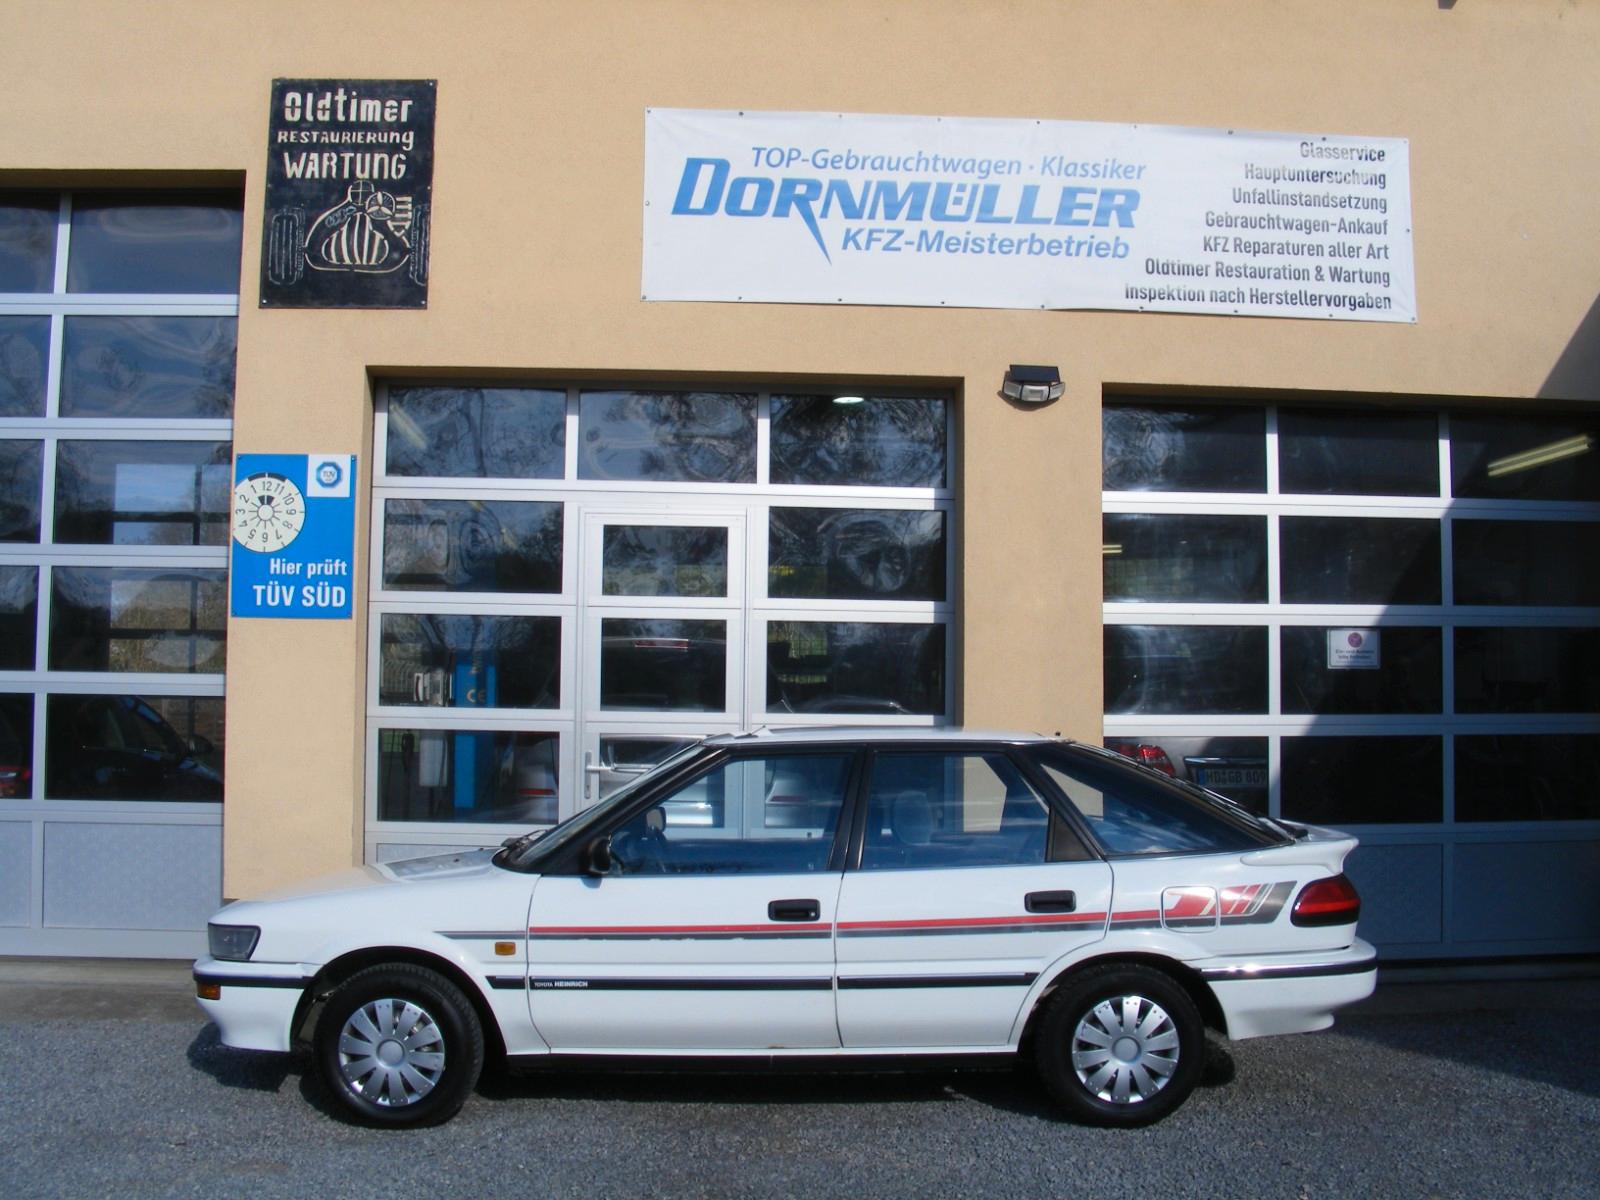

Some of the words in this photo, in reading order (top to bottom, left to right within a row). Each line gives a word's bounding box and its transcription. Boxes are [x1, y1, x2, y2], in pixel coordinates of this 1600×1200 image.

[284, 88, 414, 122] Oldtimer
[752, 146, 1022, 180] TOP-Gebrauchtwagen
[1041, 155, 1147, 180] Klassiker
[1300, 141, 1386, 162] Glasservice
[1244, 163, 1387, 190] Hauptuntersuchung
[671, 157, 1141, 266] DORNMÜLLER
[1232, 187, 1388, 214] Unfallinstandsetzung
[1205, 210, 1388, 235] Gebrauchtwagen-Ankauf
[841, 227, 1130, 259] KFZ-Meisterbetrieb
[1203, 235, 1230, 253] KFZ
[1233, 239, 1325, 257] Reparaturen
[1328, 242, 1362, 259] aller
[1366, 243, 1389, 260] Art
[1145, 257, 1211, 277] Oldtimer
[1215, 261, 1310, 282] Restauration
[1314, 265, 1325, 282] &
[1329, 266, 1390, 288] Wartung
[1209, 287, 1245, 304] nach
[1249, 287, 1392, 312] Herstellervorgaben
[262, 480, 273, 491] 12
[239, 494, 250, 504] 2
[247, 528, 257, 540] 5
[282, 520, 293, 530] 8
[269, 557, 302, 575] Hier
[307, 558, 348, 579] prüft
[252, 580, 295, 607] TÜV
[301, 581, 346, 608] SÜD
